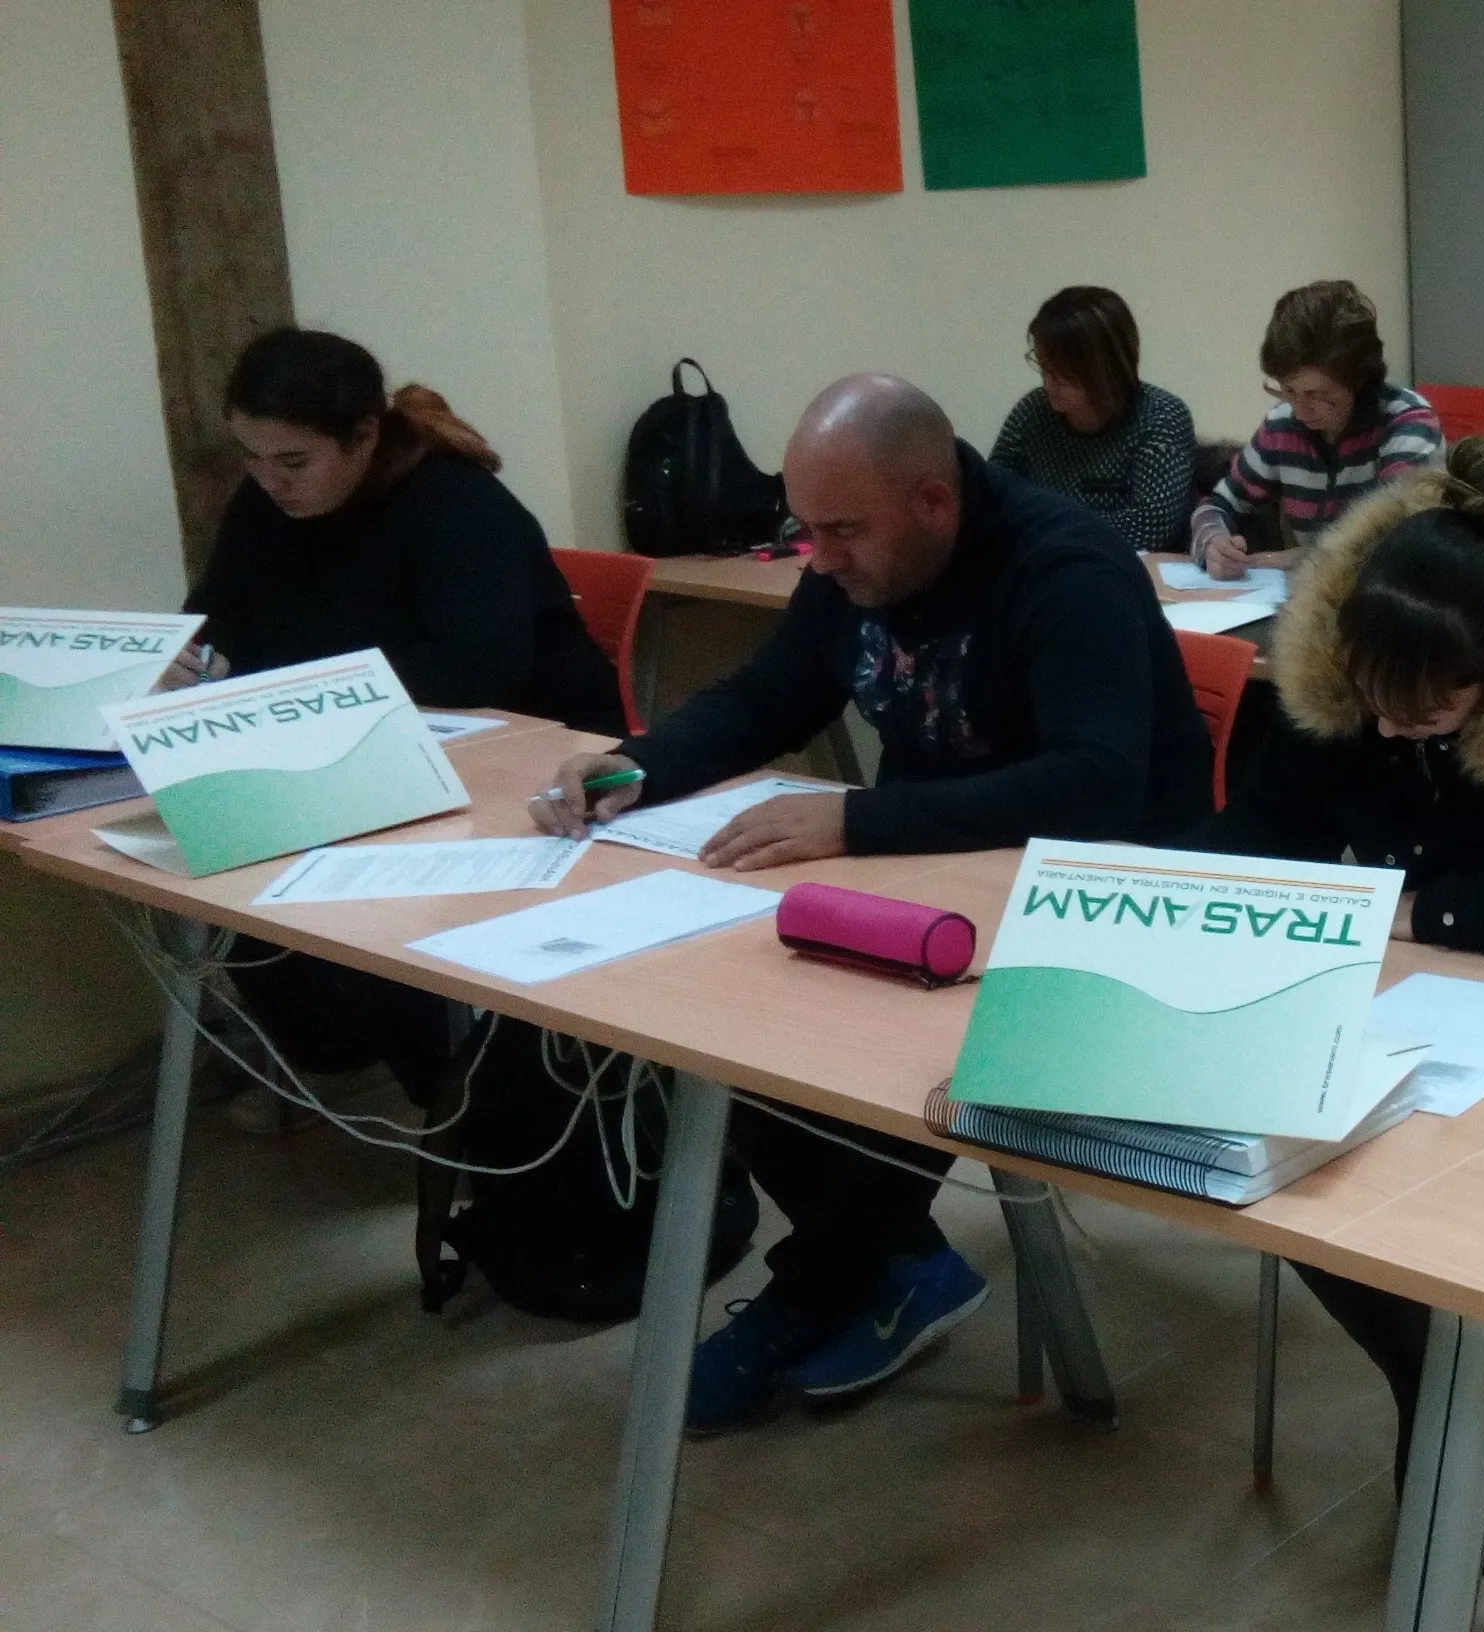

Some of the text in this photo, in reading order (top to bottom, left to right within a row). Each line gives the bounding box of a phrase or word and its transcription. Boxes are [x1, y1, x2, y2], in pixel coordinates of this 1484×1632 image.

[130, 682, 390, 755] TRASANAM
[1131, 877, 1205, 892] INDUSTRIA
[1209, 884, 1229, 895] EN
[1234, 887, 1291, 901] HIGIENE
[1295, 892, 1304, 901] E
[1309, 894, 1372, 908] CALIDAD
[1022, 884, 1362, 947] TRASANAM
